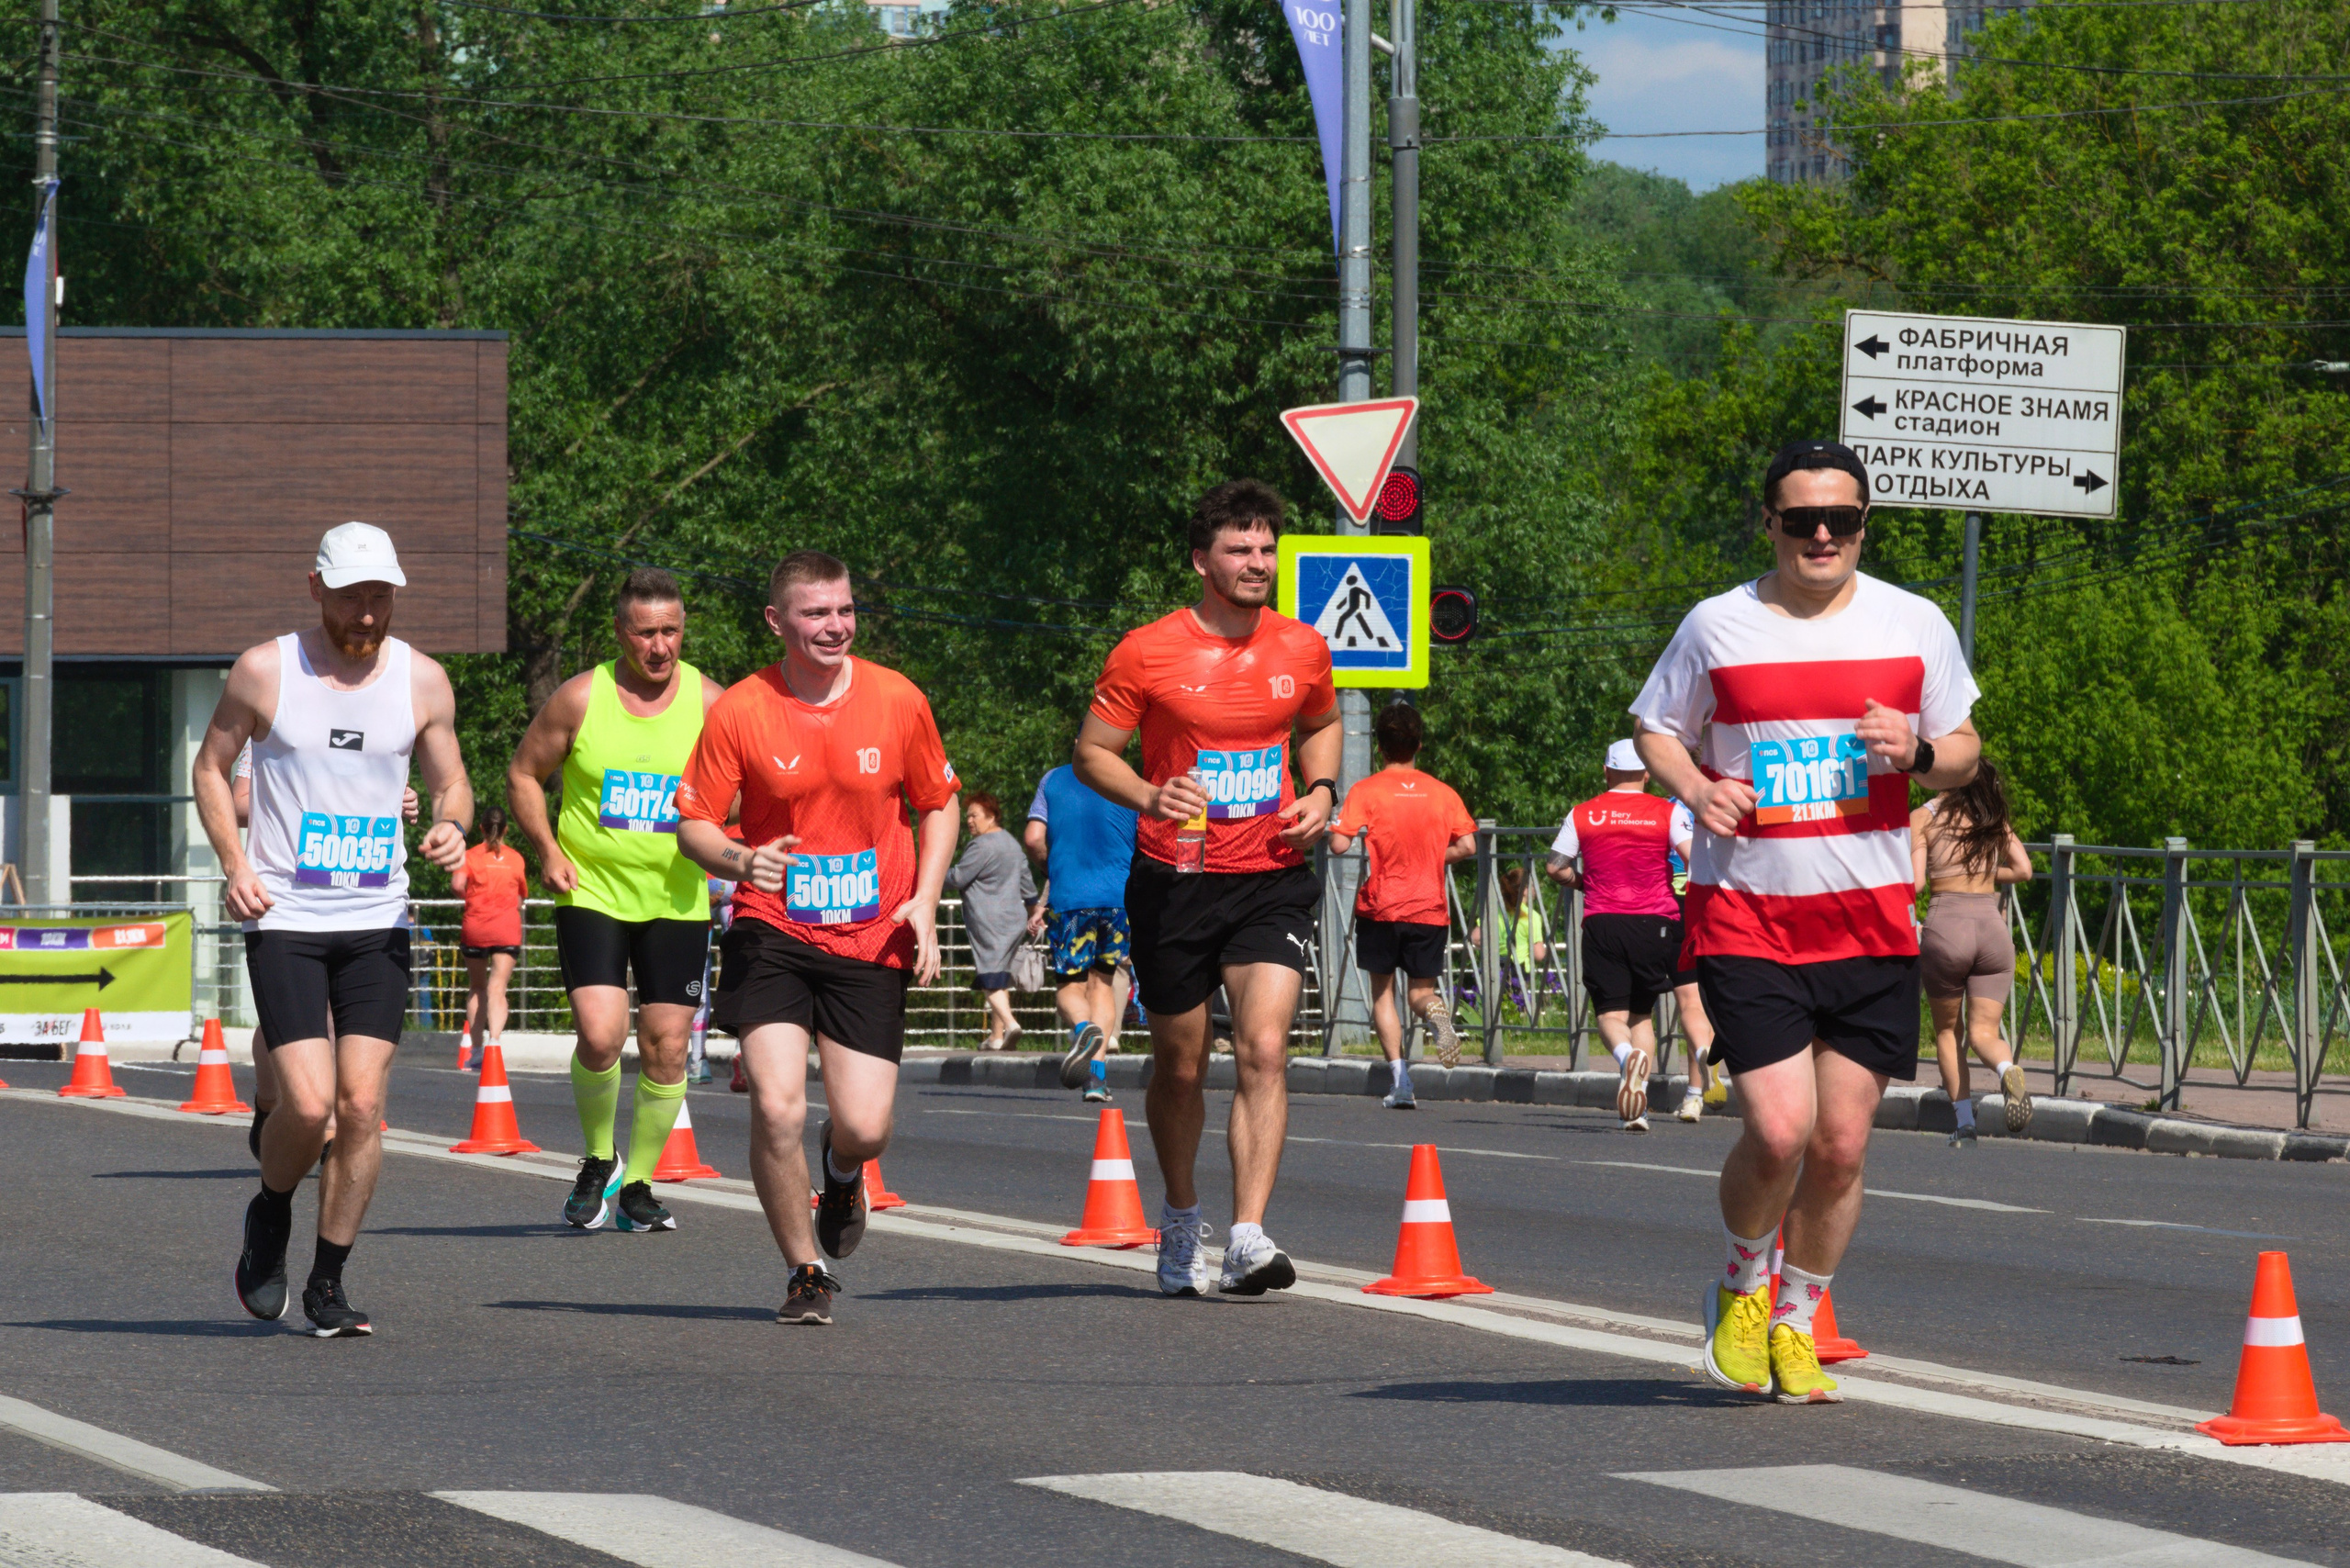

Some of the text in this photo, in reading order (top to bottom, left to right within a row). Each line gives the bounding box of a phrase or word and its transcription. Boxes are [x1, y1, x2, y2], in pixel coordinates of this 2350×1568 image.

[1293, 6, 1336, 32] 100
[1304, 28, 1330, 47] ЛЕТ
[1898, 328, 2069, 356] ФАБРИЧНАЯ
[1897, 353, 2043, 378] платформа
[1895, 389, 2109, 421] КРАСНОЕ ЗНАМЯ
[1895, 415, 2000, 436] стадион
[1853, 444, 2071, 476] ПАРК КУЛЬТУРЫ
[1874, 474, 1990, 500] ОТДЫХА
[1268, 675, 1294, 700] 10
[856, 747, 881, 774] 10
[1799, 740, 1818, 758] 10
[1239, 754, 1254, 768] 10
[640, 774, 655, 789] 10
[1202, 765, 1279, 803] 50098
[1766, 756, 1855, 803] 70161
[609, 786, 677, 820] 50174
[1227, 802, 1257, 819] 10KM
[1792, 801, 1836, 823] 21.1KM
[344, 818, 361, 834] 10
[628, 819, 655, 833] 10KM
[1611, 811, 1631, 820] Бегу
[304, 832, 389, 870] 50035
[827, 857, 844, 873] 10
[330, 871, 361, 888] 10KM
[794, 869, 873, 907] 50100
[820, 909, 852, 924] 10KM
